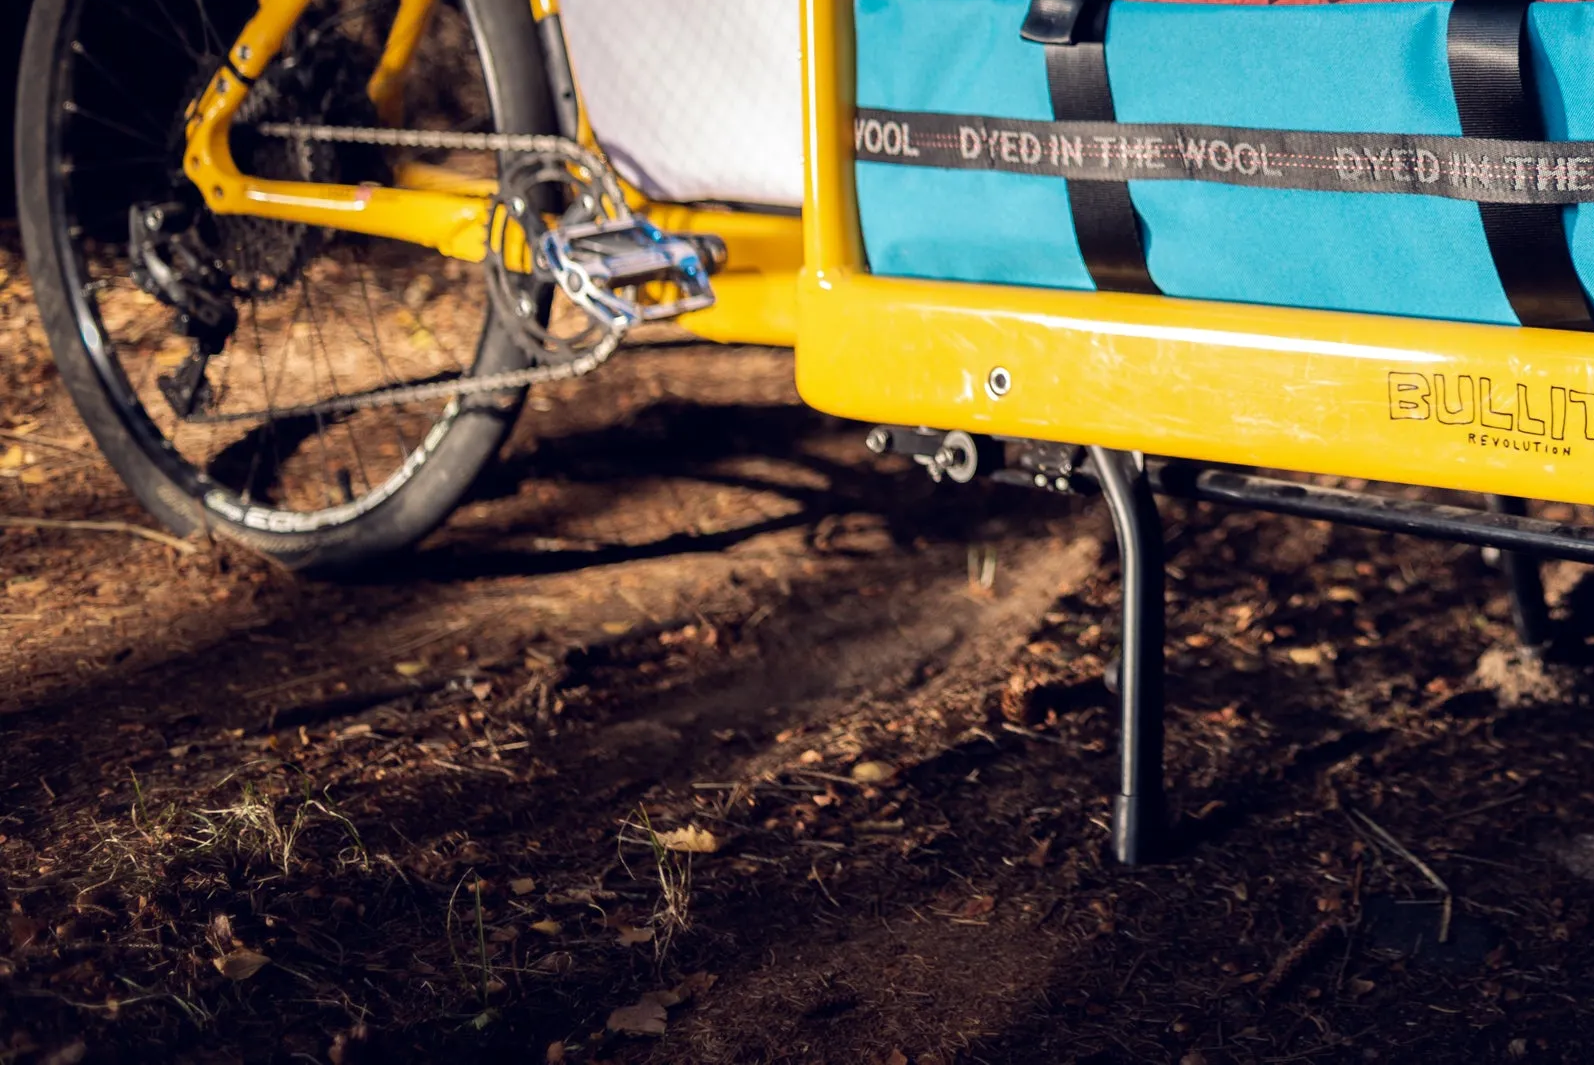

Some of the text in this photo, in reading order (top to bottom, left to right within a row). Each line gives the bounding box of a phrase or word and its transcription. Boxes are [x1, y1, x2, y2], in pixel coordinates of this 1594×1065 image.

[958, 125, 1042, 165] DYED
[1050, 135, 1083, 168] IN
[1094, 135, 1166, 169] THE
[1177, 137, 1282, 177] WOOL
[1335, 146, 1441, 184] DYED
[1451, 150, 1493, 188] IN
[1504, 155, 1593, 191] THE
[1467, 432, 1572, 457] REVOLUTION
